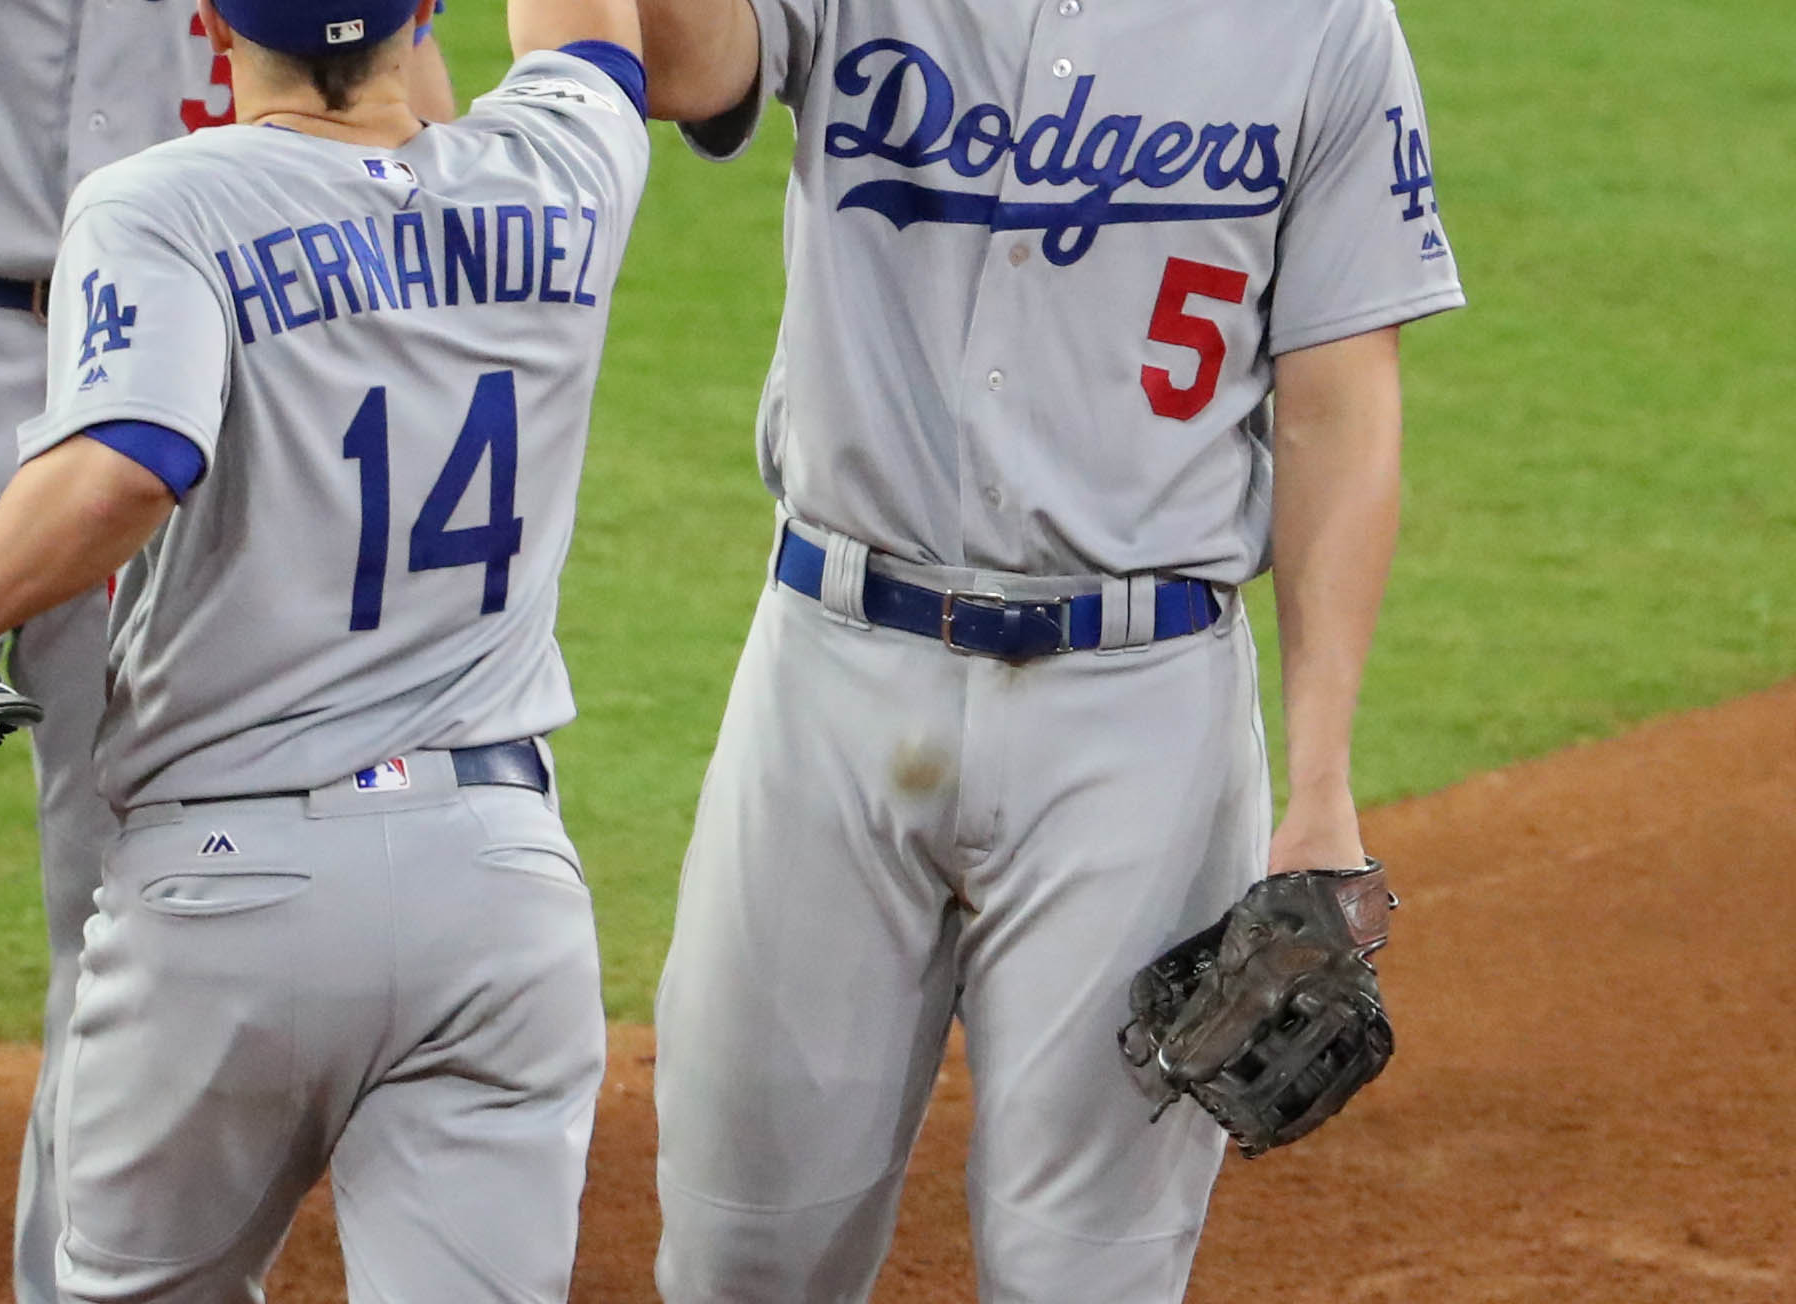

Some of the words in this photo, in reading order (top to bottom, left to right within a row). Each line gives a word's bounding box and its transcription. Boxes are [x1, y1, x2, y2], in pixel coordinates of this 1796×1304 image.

[824, 38, 1287, 267] Dodgers
[1385, 106, 1439, 222] LA
[77, 268, 138, 369] LA
[1139, 256, 1249, 423] 5
[342, 369, 524, 633] 14
